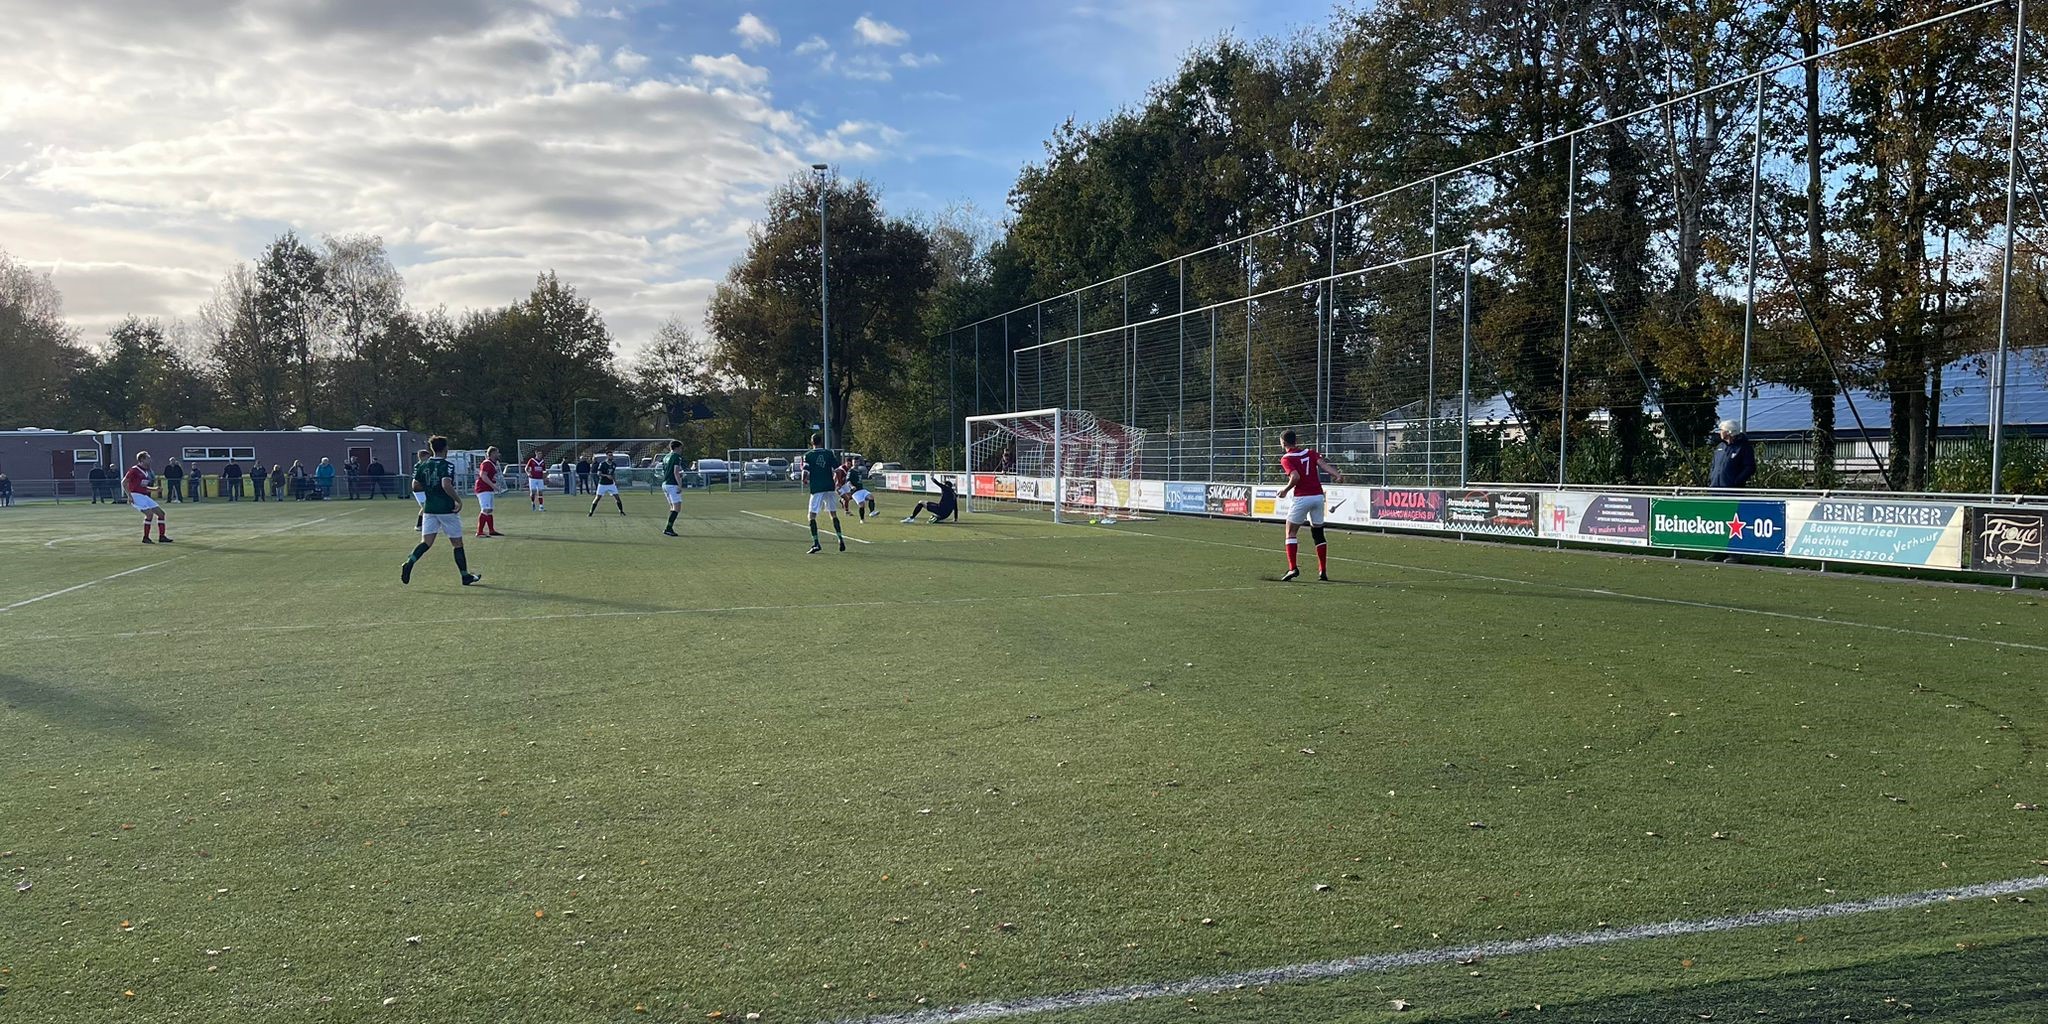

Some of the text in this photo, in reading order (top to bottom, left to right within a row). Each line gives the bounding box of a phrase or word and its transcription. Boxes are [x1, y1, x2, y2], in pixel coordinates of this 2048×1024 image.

[1300, 457, 1310, 475] 7
[1166, 484, 1181, 508] kps
[1385, 491, 1425, 508] JOZUA
[1823, 503, 1942, 525] RENÉ DEKKER
[1654, 514, 1725, 535] Heineken
[1809, 523, 1899, 538] Bouwmaterieel
[1802, 535, 1849, 547] Machine
[1893, 531, 1939, 553] Verhuur
